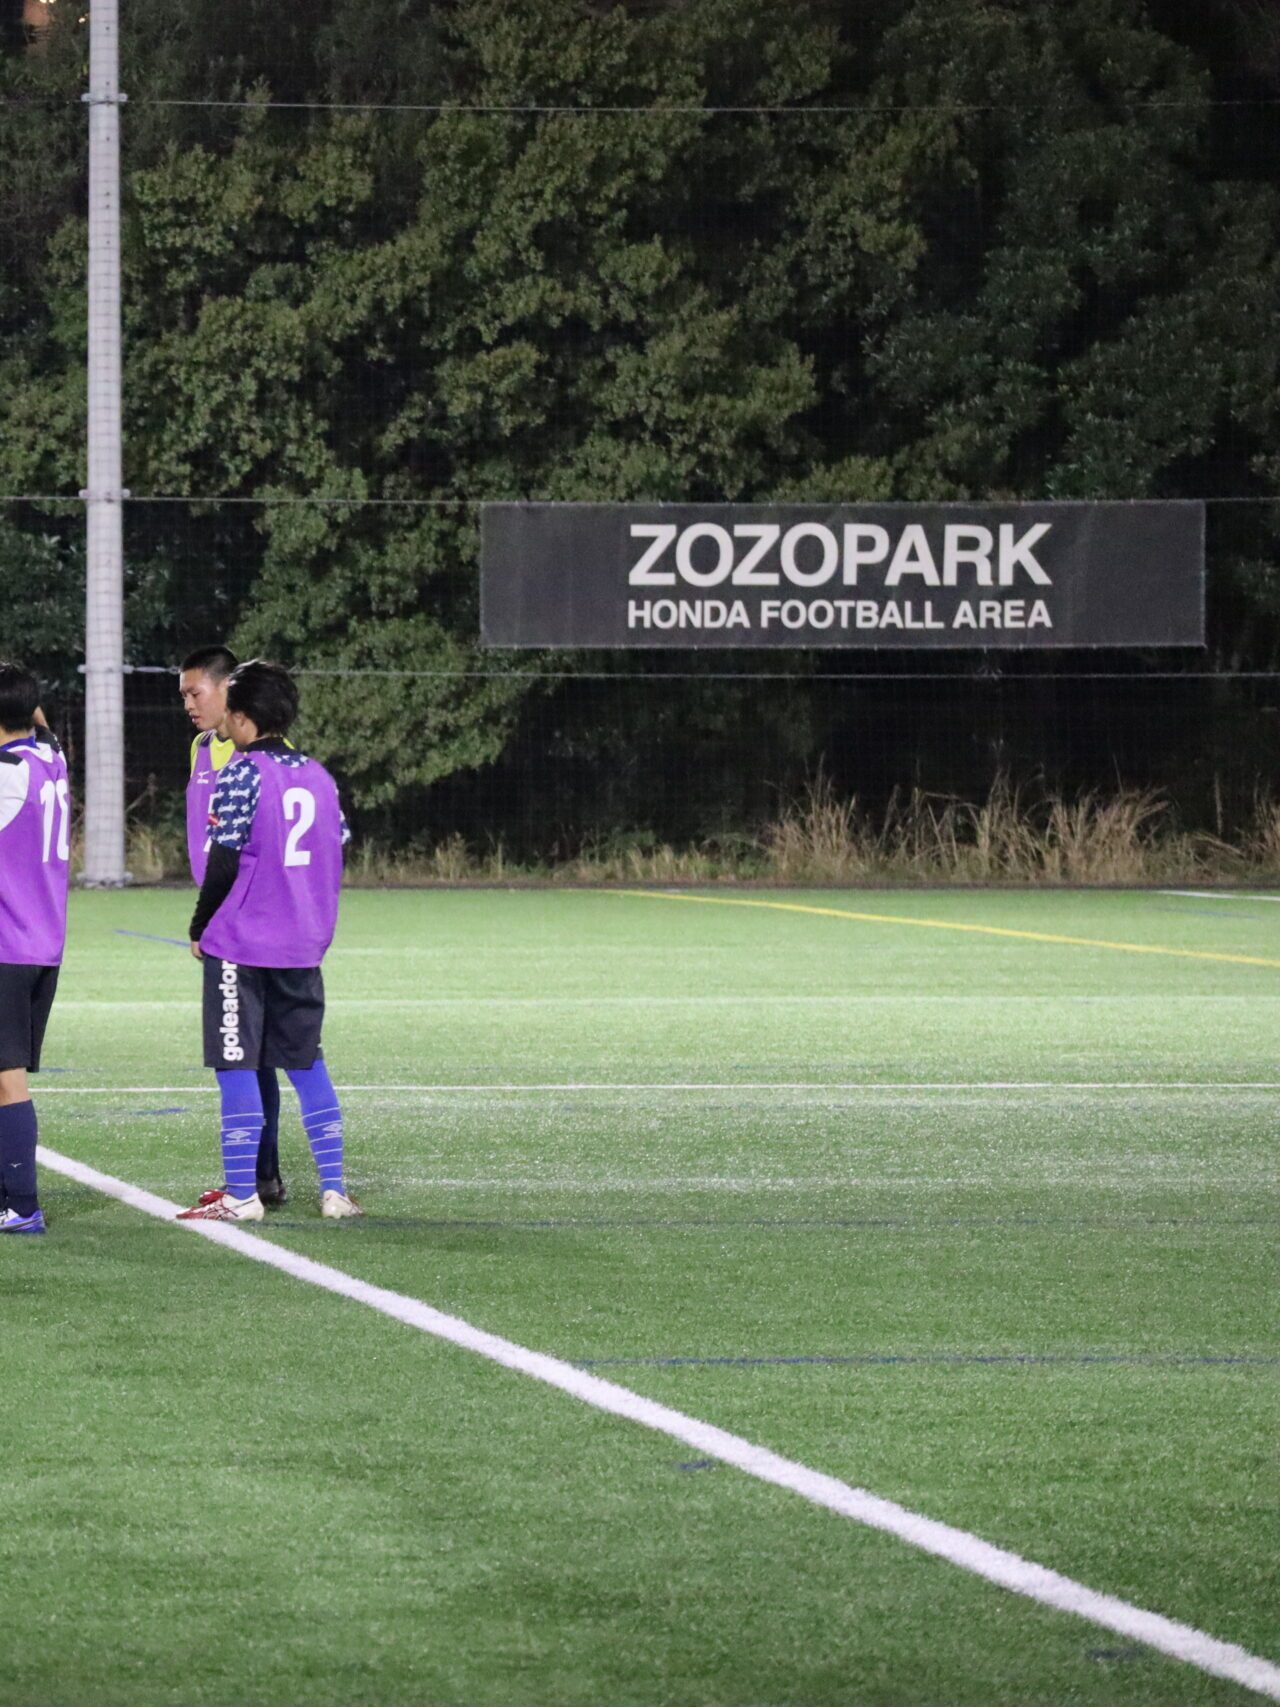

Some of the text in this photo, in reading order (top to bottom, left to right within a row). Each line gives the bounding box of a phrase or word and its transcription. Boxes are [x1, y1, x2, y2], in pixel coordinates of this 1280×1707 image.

[628, 522, 1053, 588] ZOZOPARK
[627, 599, 1053, 630] HONDA FOOTBALL AREA
[282, 786, 316, 867] 2
[218, 959, 245, 1062] goleador
